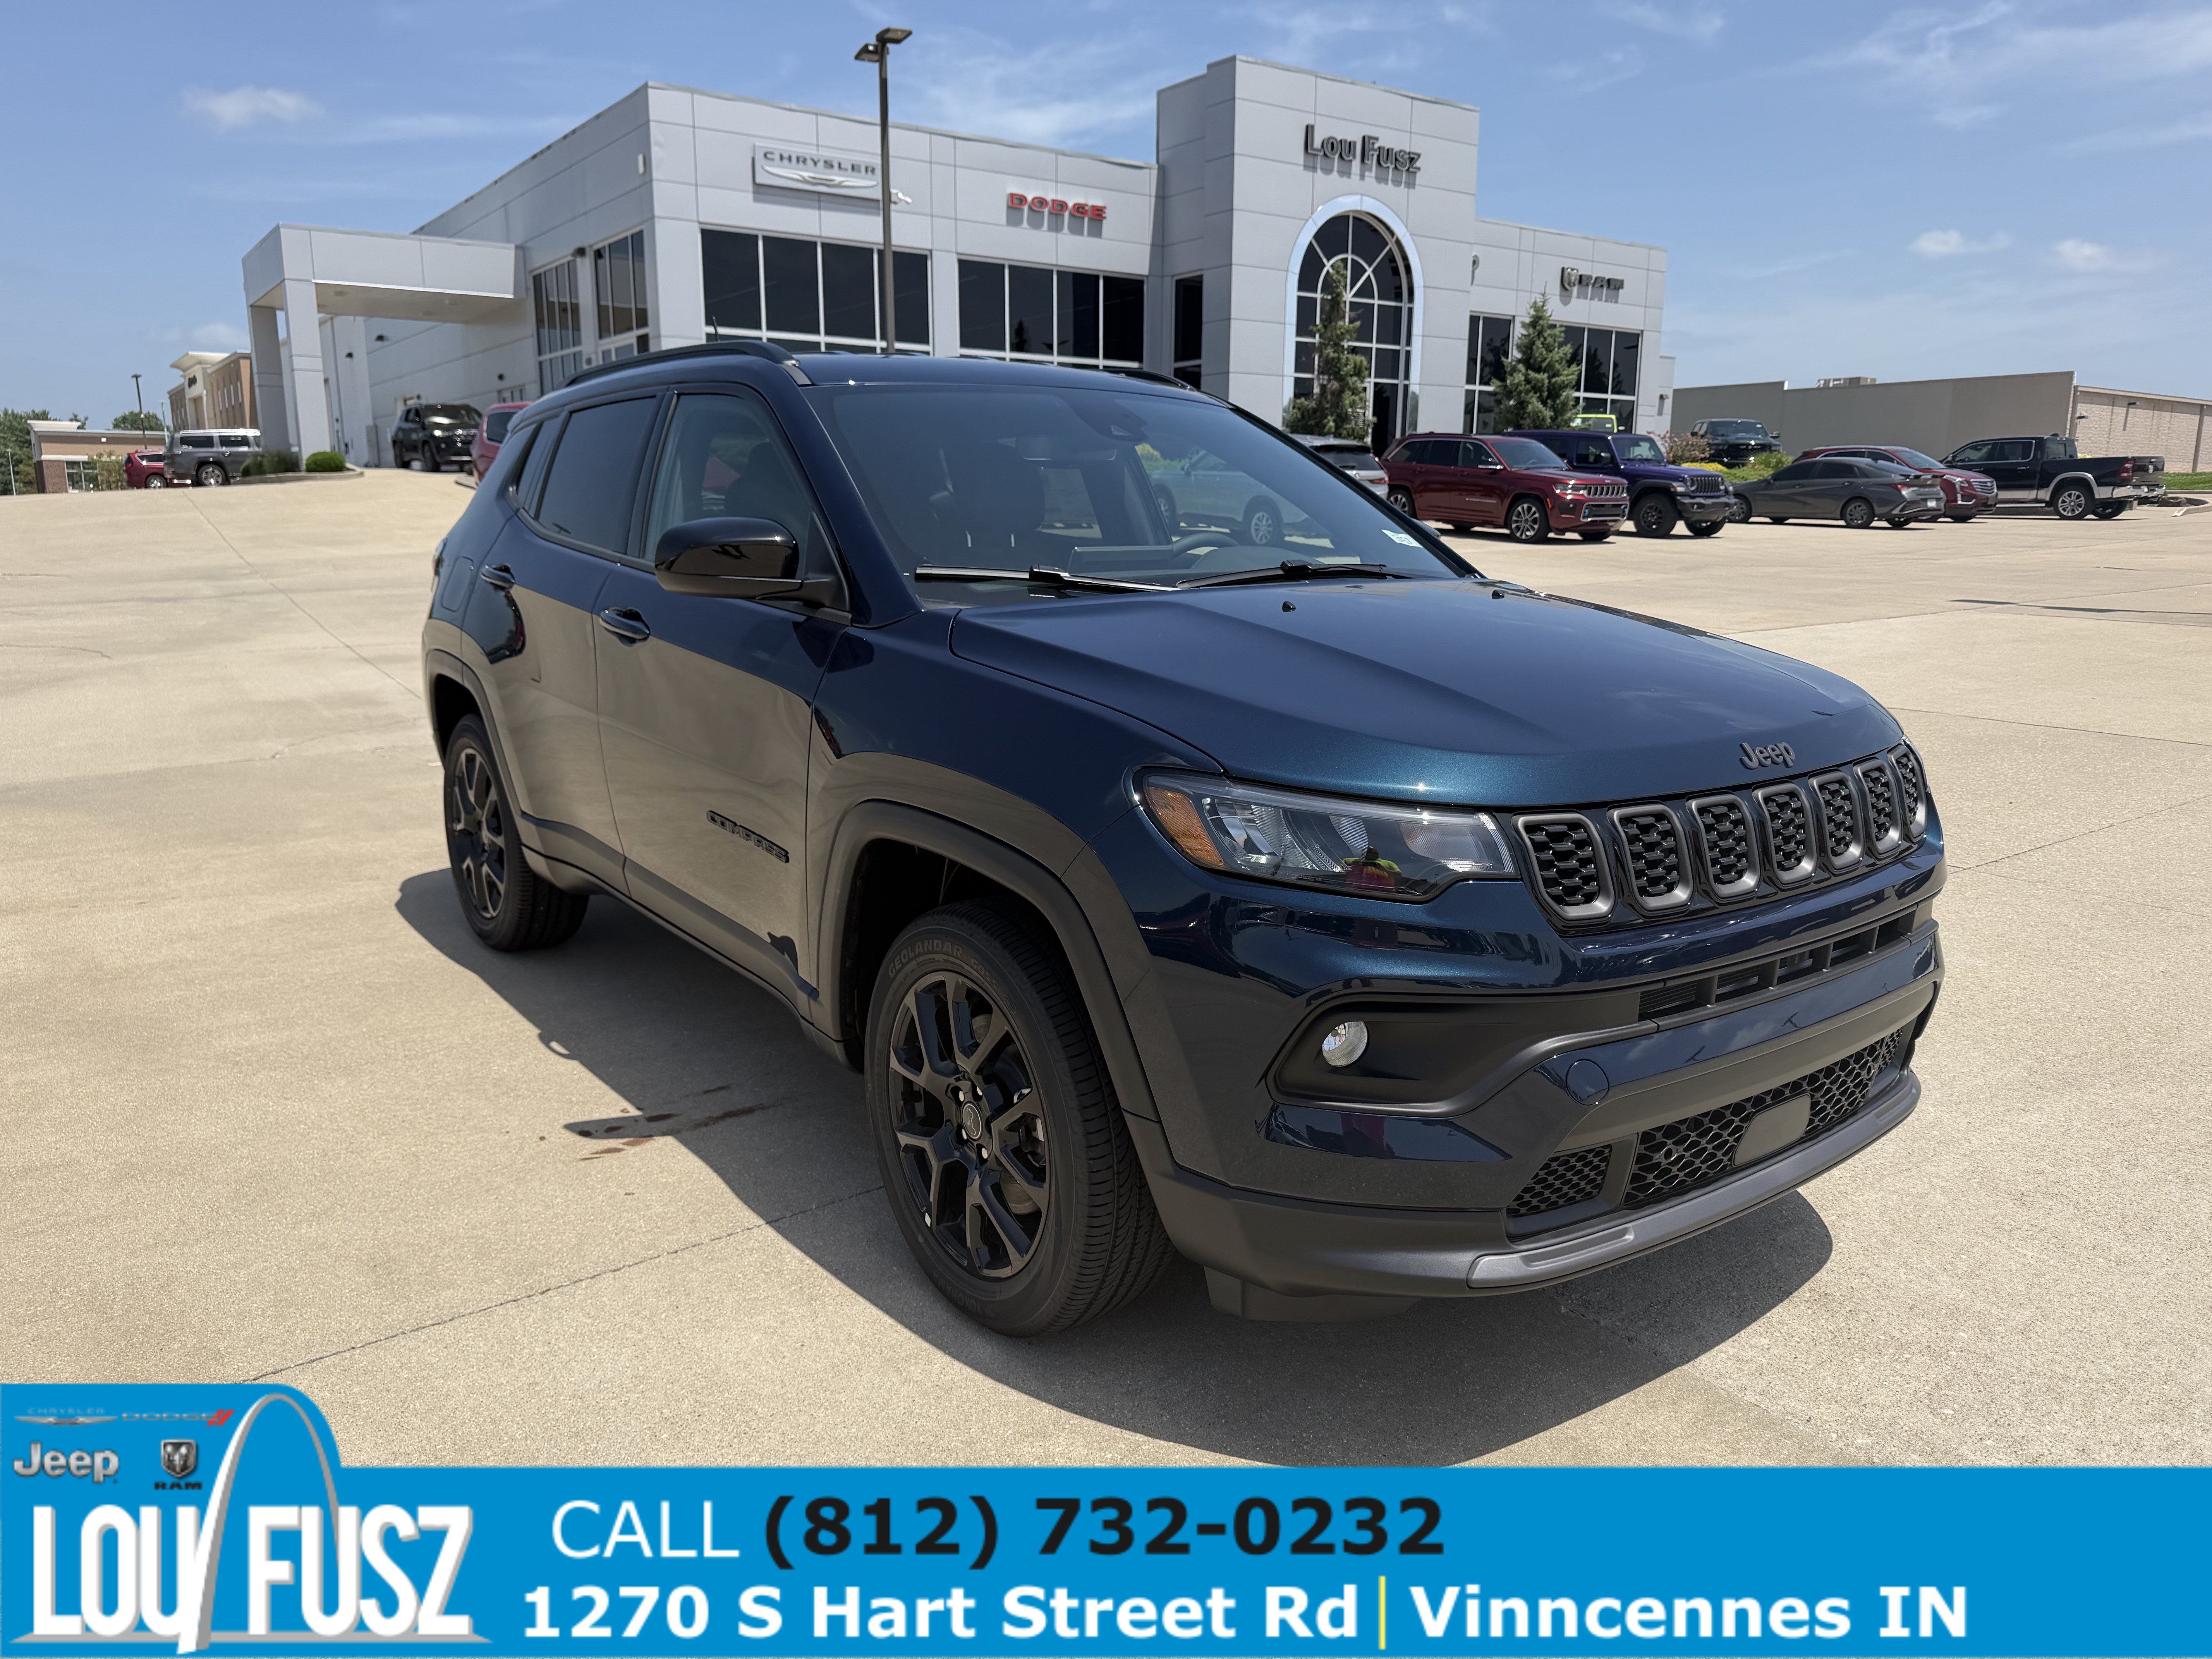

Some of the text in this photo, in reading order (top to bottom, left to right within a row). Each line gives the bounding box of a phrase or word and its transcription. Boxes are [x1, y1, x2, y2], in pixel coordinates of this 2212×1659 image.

[1305, 124, 1422, 172] Lou Fusz
[763, 151, 876, 175] CHRYSLER
[1007, 192, 1106, 220] DODGE
[1578, 274, 1624, 289] RAM
[1739, 742, 1796, 769] Jeep
[706, 810, 790, 863] COMPASS
[888, 939, 963, 979] GEOLANDAR
